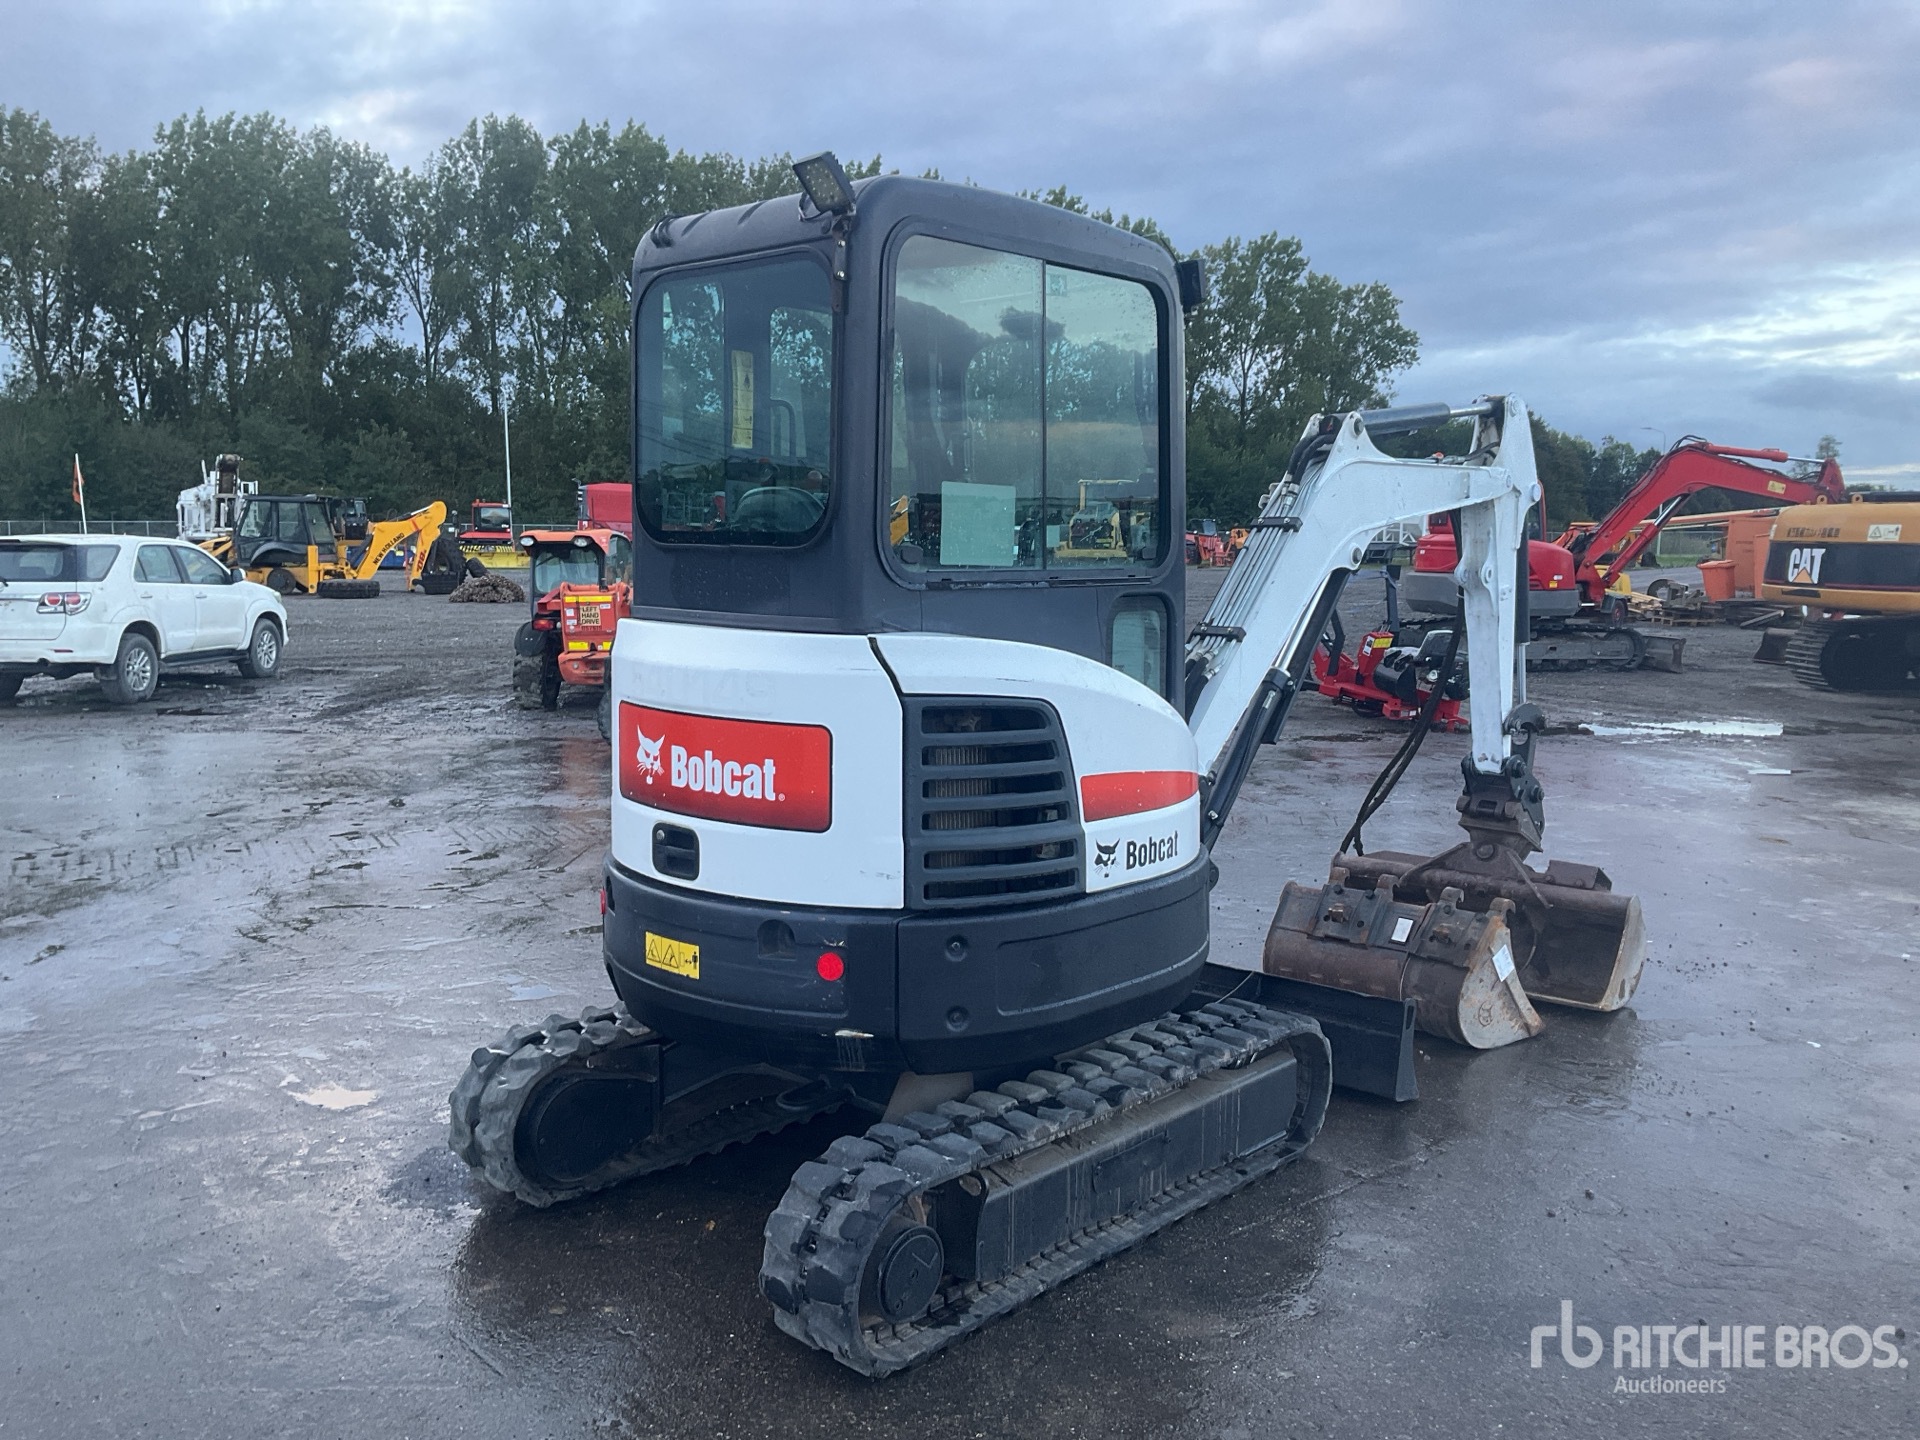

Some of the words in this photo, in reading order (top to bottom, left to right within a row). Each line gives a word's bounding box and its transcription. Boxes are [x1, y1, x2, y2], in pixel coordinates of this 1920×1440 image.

[373, 552, 384, 565] NEW
[382, 532, 405, 554] HOLLAND
[1787, 548, 1826, 584] CAT
[671, 745, 776, 802] Bobcat
[1126, 830, 1178, 870] Bobcat
